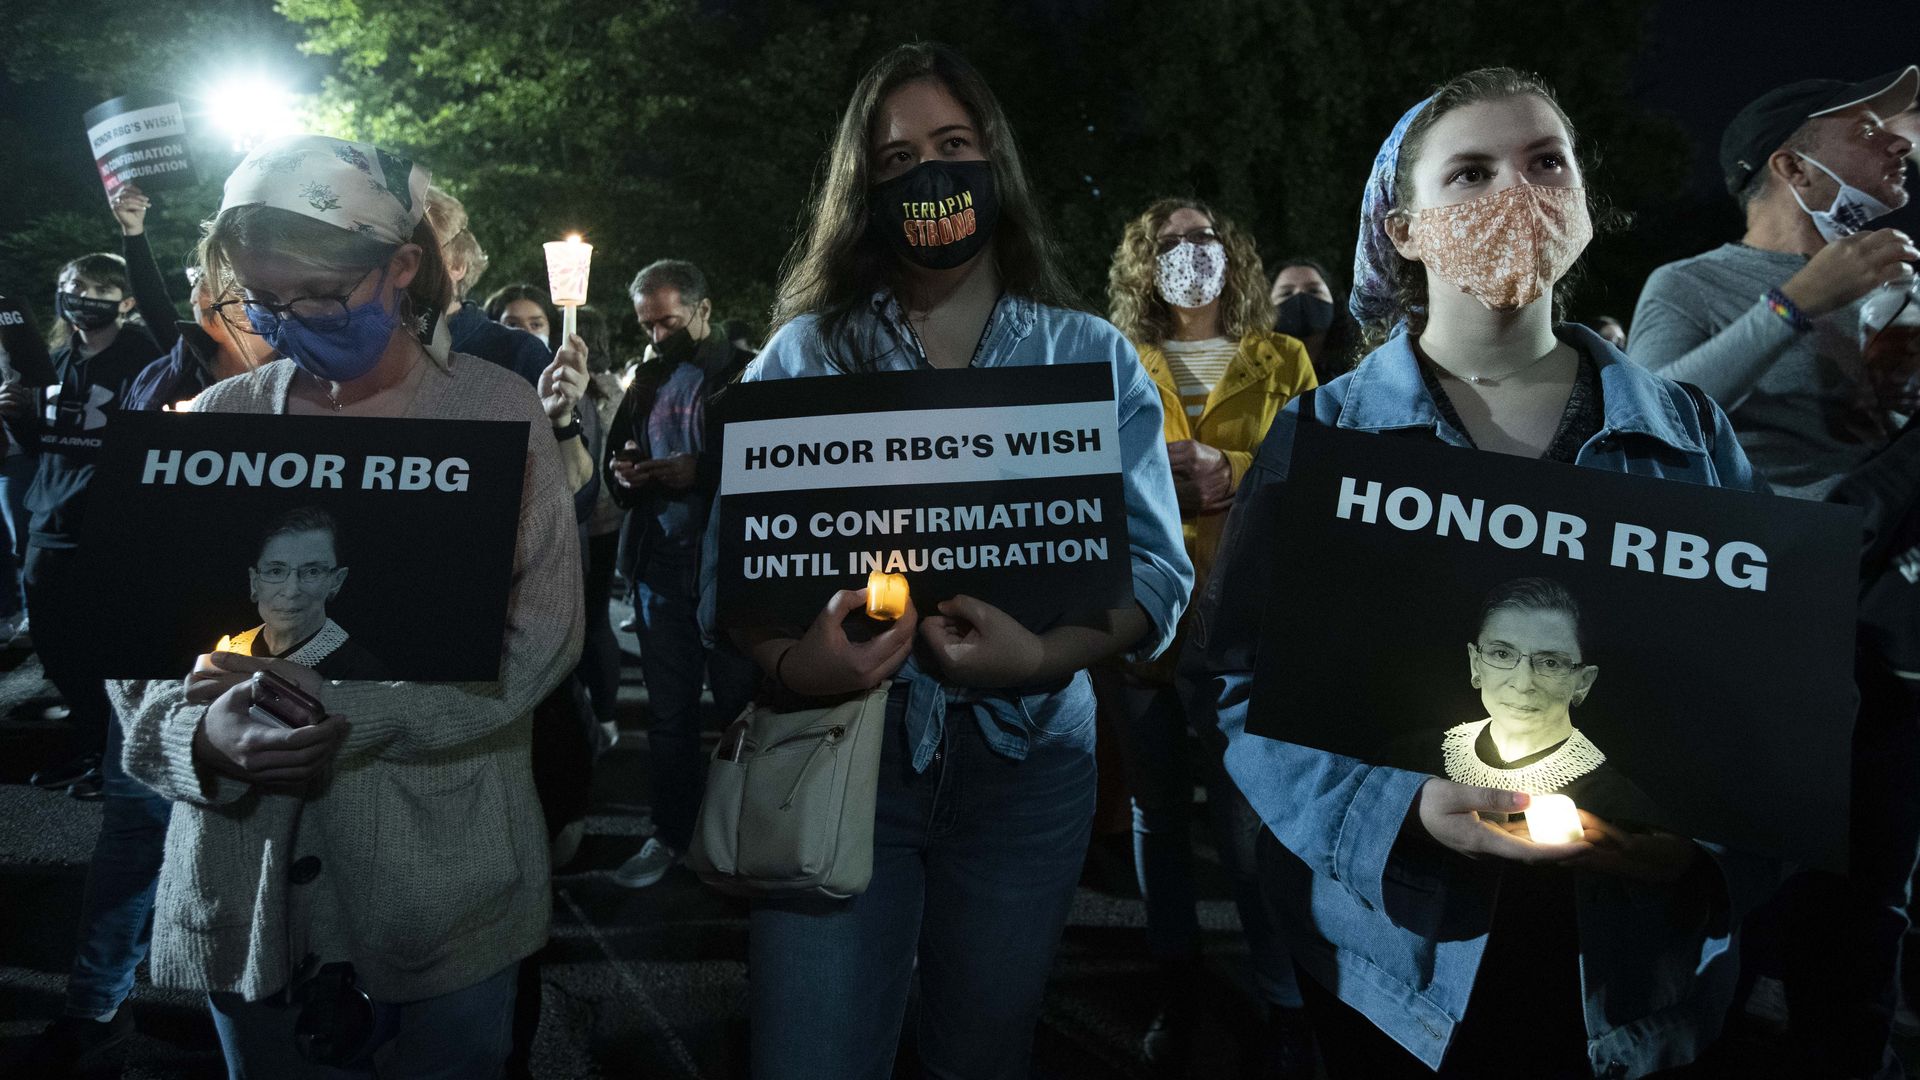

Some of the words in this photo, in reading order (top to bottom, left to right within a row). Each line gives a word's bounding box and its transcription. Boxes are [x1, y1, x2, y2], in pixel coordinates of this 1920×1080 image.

[143, 114, 177, 131] WISH
[108, 144, 183, 171] CONFIRMATION
[903, 190, 973, 218] TERRAPIN
[903, 207, 977, 247] STRONG
[141, 449, 346, 489] HONOR
[361, 455, 470, 492] RBG
[745, 439, 874, 471] HONOR
[885, 433, 995, 462] RBG'S
[1004, 428, 1102, 457] WISH
[744, 513, 798, 541] NO
[809, 498, 1103, 538] CONFIRMATION
[1336, 476, 1588, 561] HONOR
[1610, 521, 1769, 592] RBG
[743, 552, 840, 580] UNTIL
[849, 537, 1109, 575] INAUGURATION
